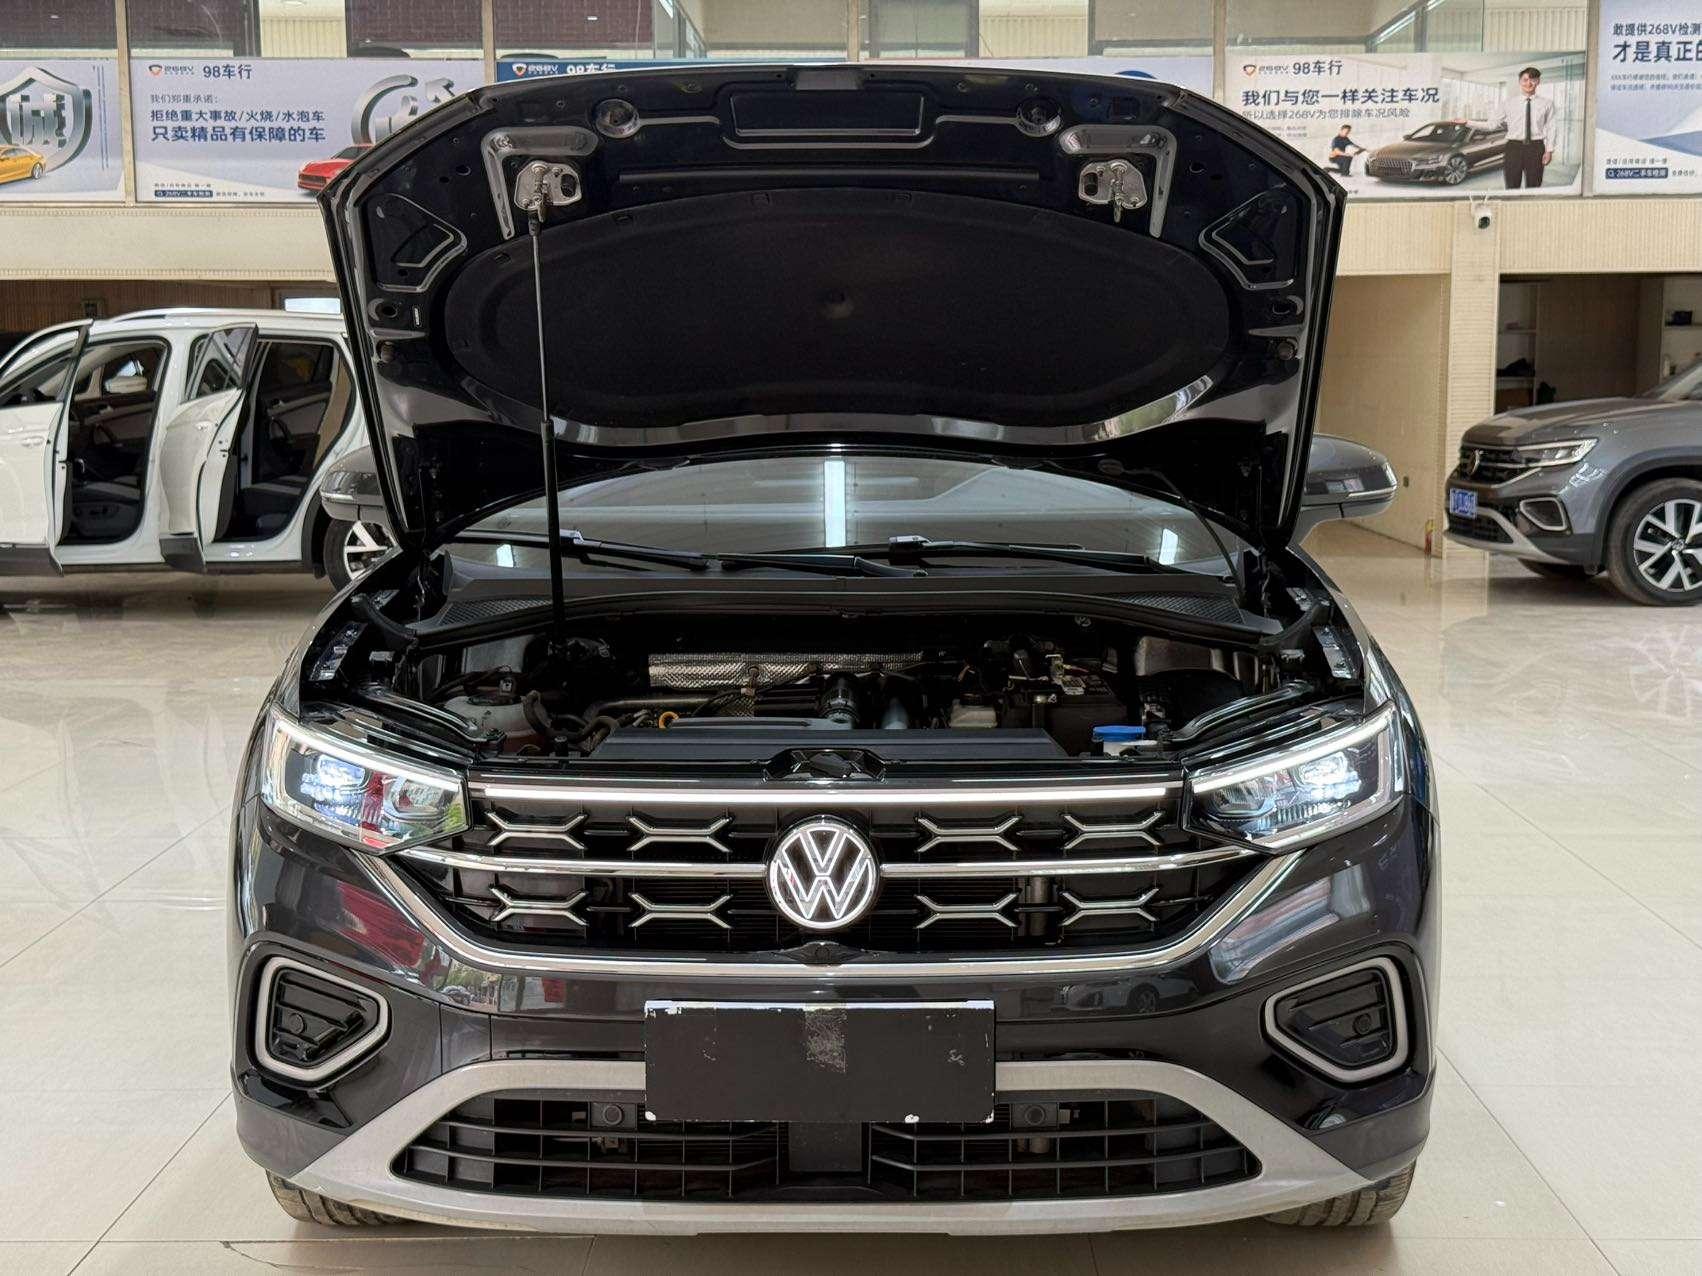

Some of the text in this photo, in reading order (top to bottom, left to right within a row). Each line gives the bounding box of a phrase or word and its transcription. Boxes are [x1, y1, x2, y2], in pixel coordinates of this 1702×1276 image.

[202, 64, 252, 79] 98车行
[1292, 60, 1343, 76] 98车行
[1242, 87, 1440, 106] 我们与您一样关注车况
[150, 109, 325, 123] 拒绝重大事故/火烧/水泡车
[151, 125, 326, 143] 只卖精品有保障的车
[772, 825, 874, 926] VW
